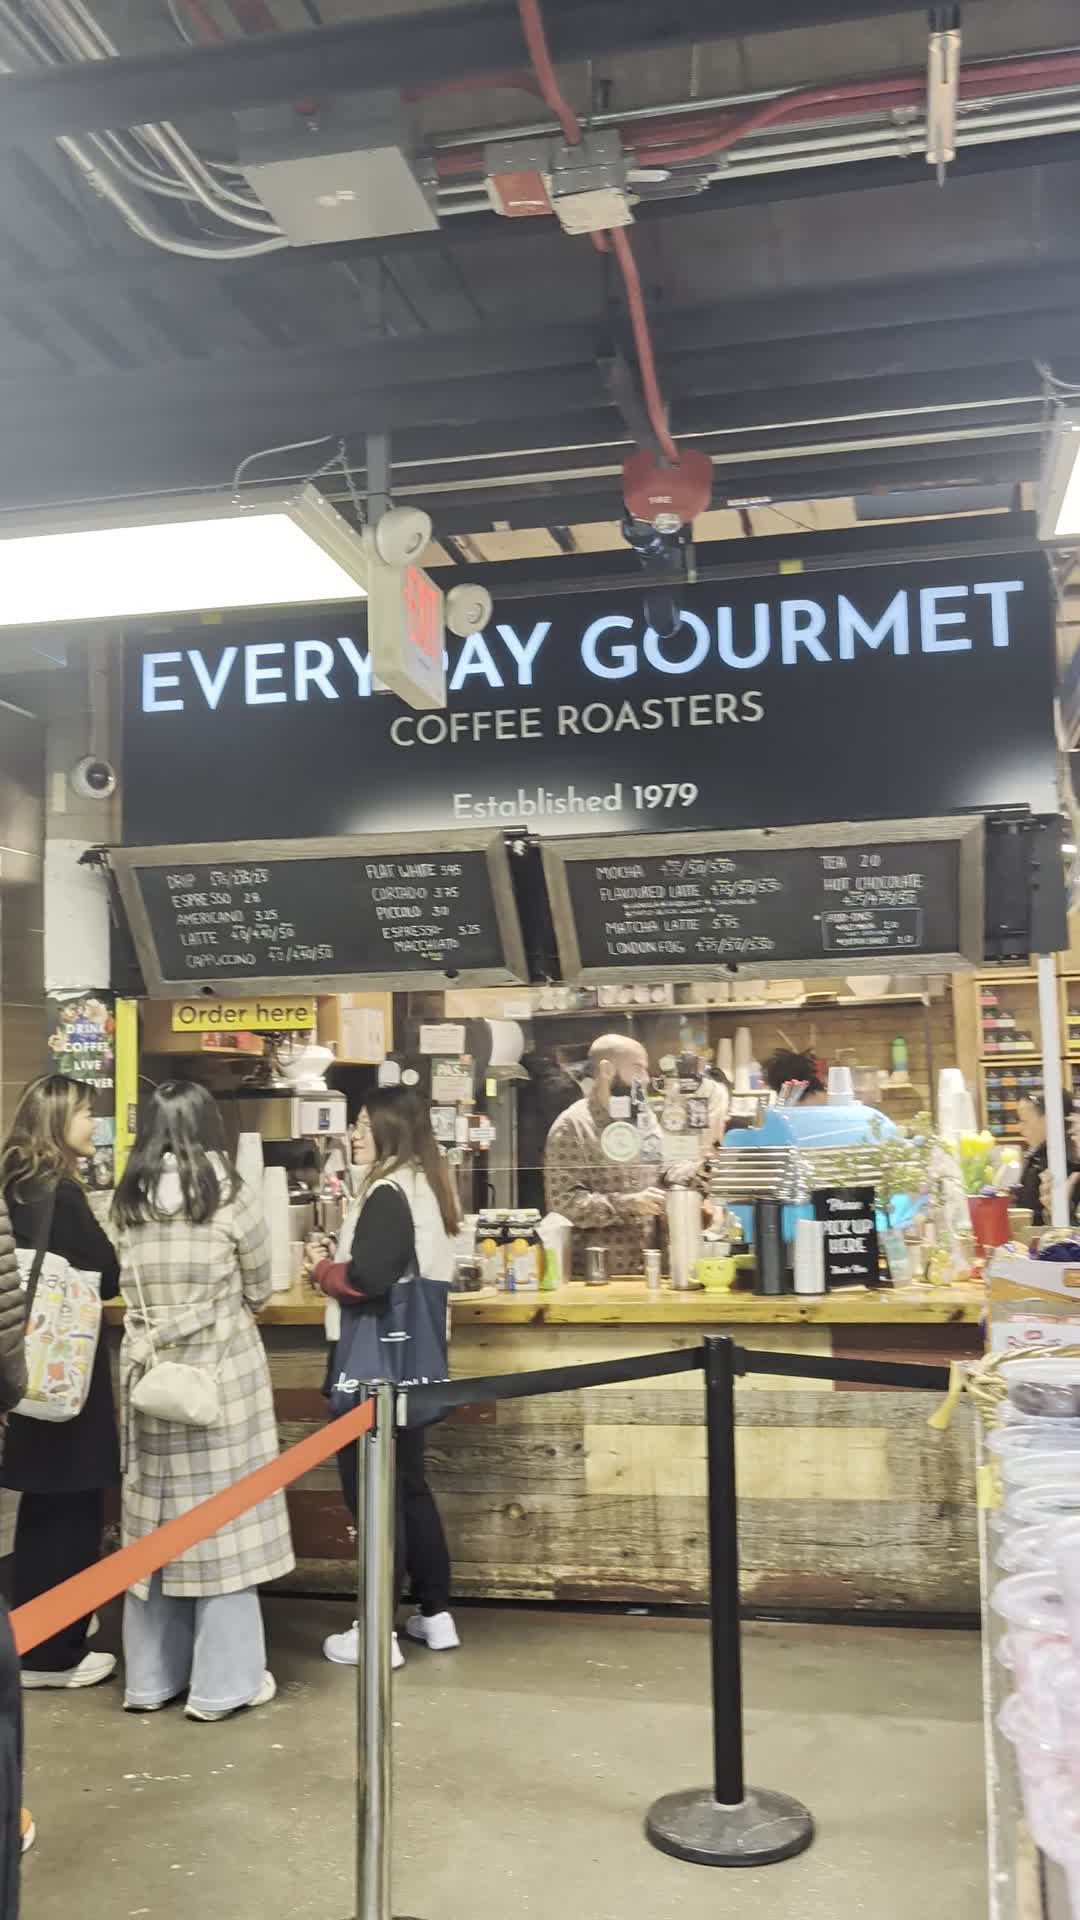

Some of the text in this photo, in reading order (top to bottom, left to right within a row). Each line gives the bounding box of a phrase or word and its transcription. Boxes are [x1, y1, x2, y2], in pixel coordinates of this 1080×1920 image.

[141, 579, 1025, 713] EVERYAY GOURMET
[389, 691, 765, 747] COFFEE ROASTERS
[452, 782, 699, 820] Established 1979
[365, 863, 396, 879] FLAT
[398, 863, 437, 878] WHITE
[596, 864, 645, 880] MOCHA
[823, 873, 924, 891] HOT CHOCOLATE
[171, 891, 232, 908] ESPRESSO
[371, 886, 428, 901] CORTADO
[600, 884, 665, 901] FLAVOURED
[669, 884, 700, 898] LATTE
[176, 909, 244, 925] AMERICANO
[376, 905, 422, 920] PICCOLO
[605, 920, 660, 934] MATCHA
[664, 918, 700, 931] LATTE
[180, 931, 219, 946] LATTE
[607, 941, 657, 955] LONDON
[658, 940, 686, 954] FOG
[178, 1003, 308, 1024] Order here
[63, 1042, 110, 1053] COFFEE
[73, 1060, 103, 1071] LIVE
[852, 1218, 874, 1235] UP
[828, 1237, 868, 1254] HERE
